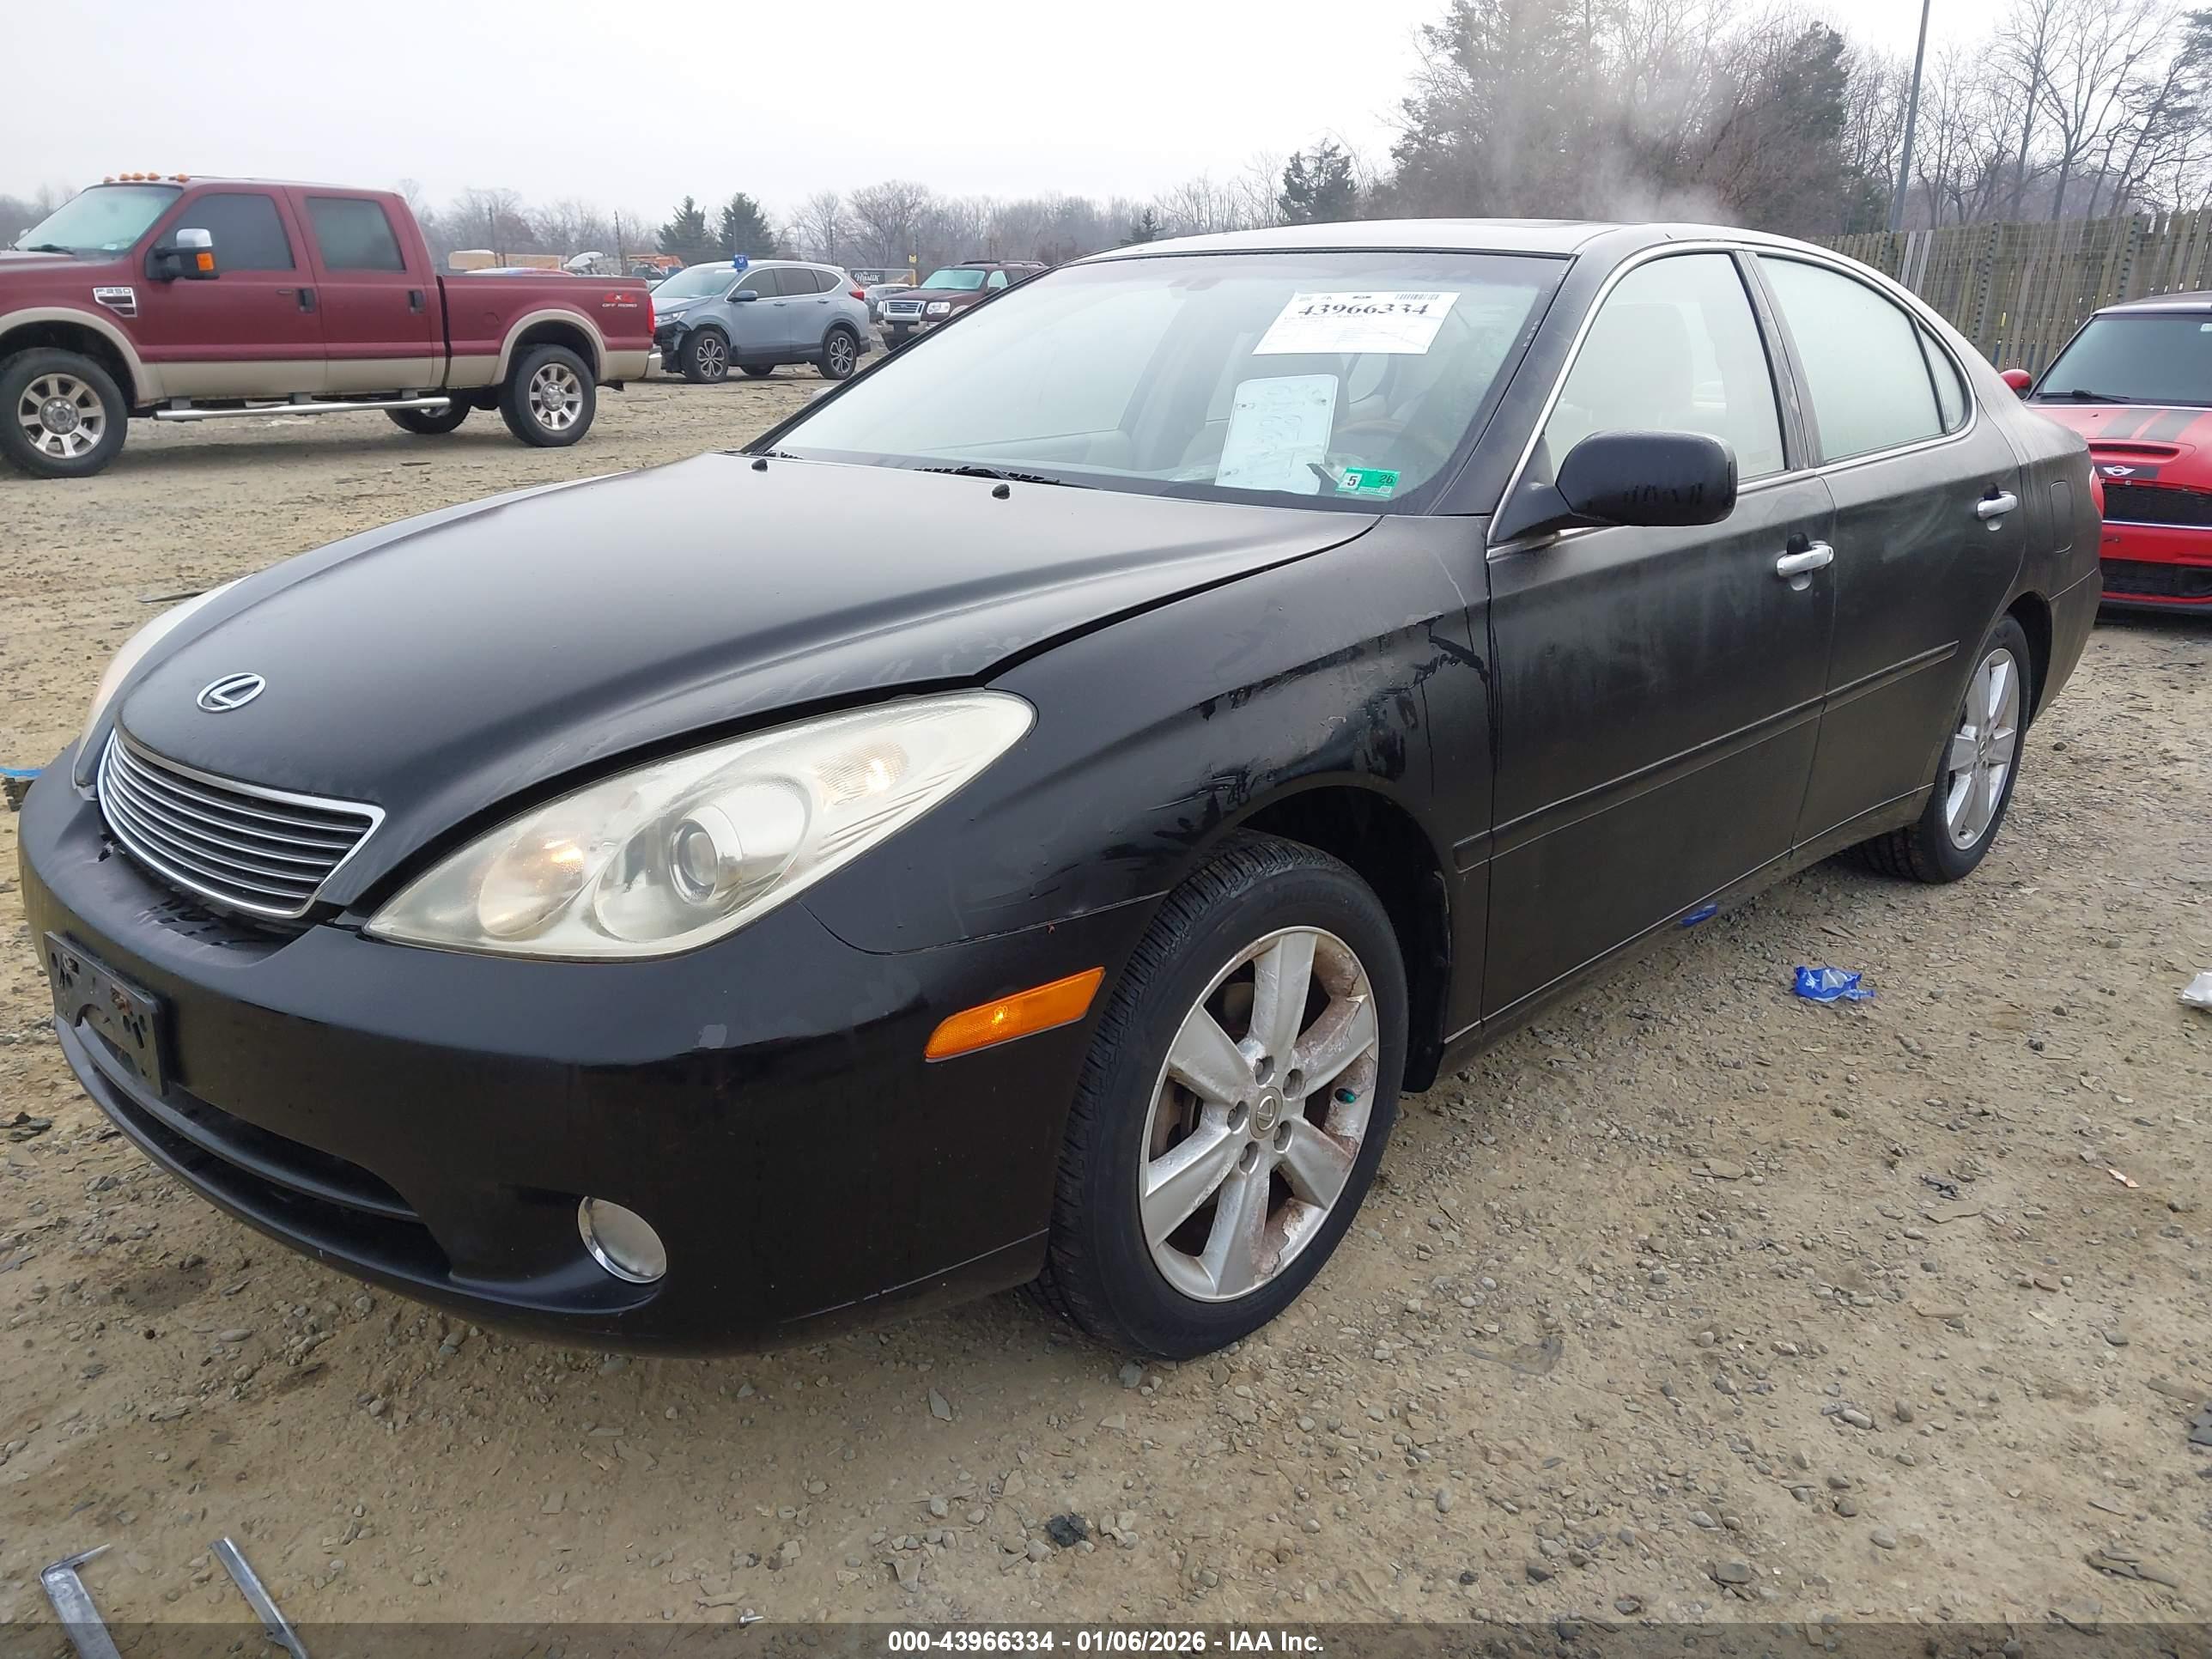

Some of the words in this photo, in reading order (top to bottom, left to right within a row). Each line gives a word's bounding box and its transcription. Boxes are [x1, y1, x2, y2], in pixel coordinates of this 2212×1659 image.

[1297, 303, 1429, 316] 43966334
[1347, 476, 1358, 486] 5
[1379, 474, 1395, 484] 26
